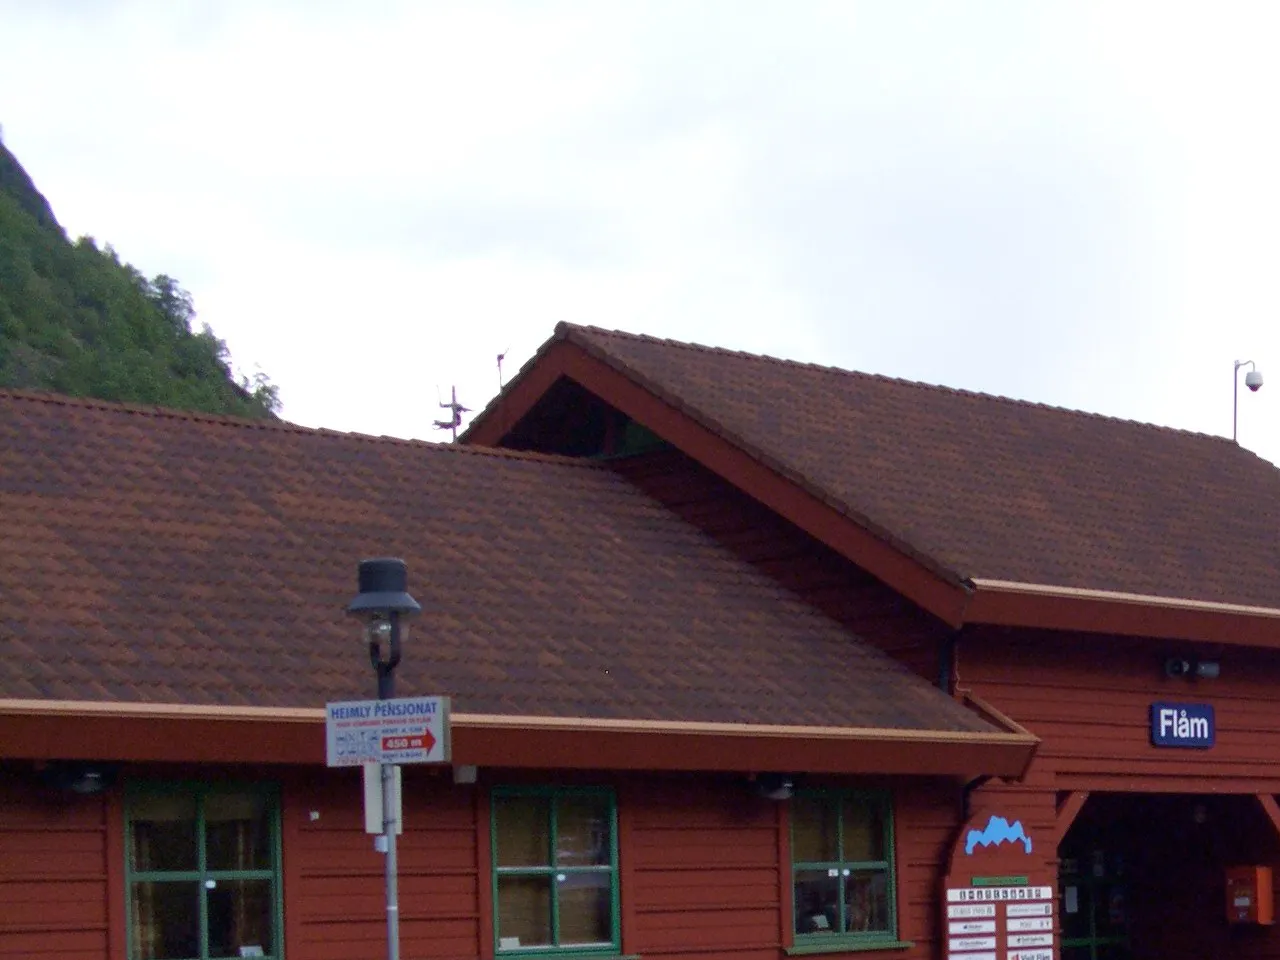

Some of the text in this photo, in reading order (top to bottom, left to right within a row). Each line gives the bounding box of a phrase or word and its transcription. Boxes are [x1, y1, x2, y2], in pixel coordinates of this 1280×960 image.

[331, 702, 437, 719] HEIMLY PENSJONAT
[1160, 708, 1209, 739] Flåm
